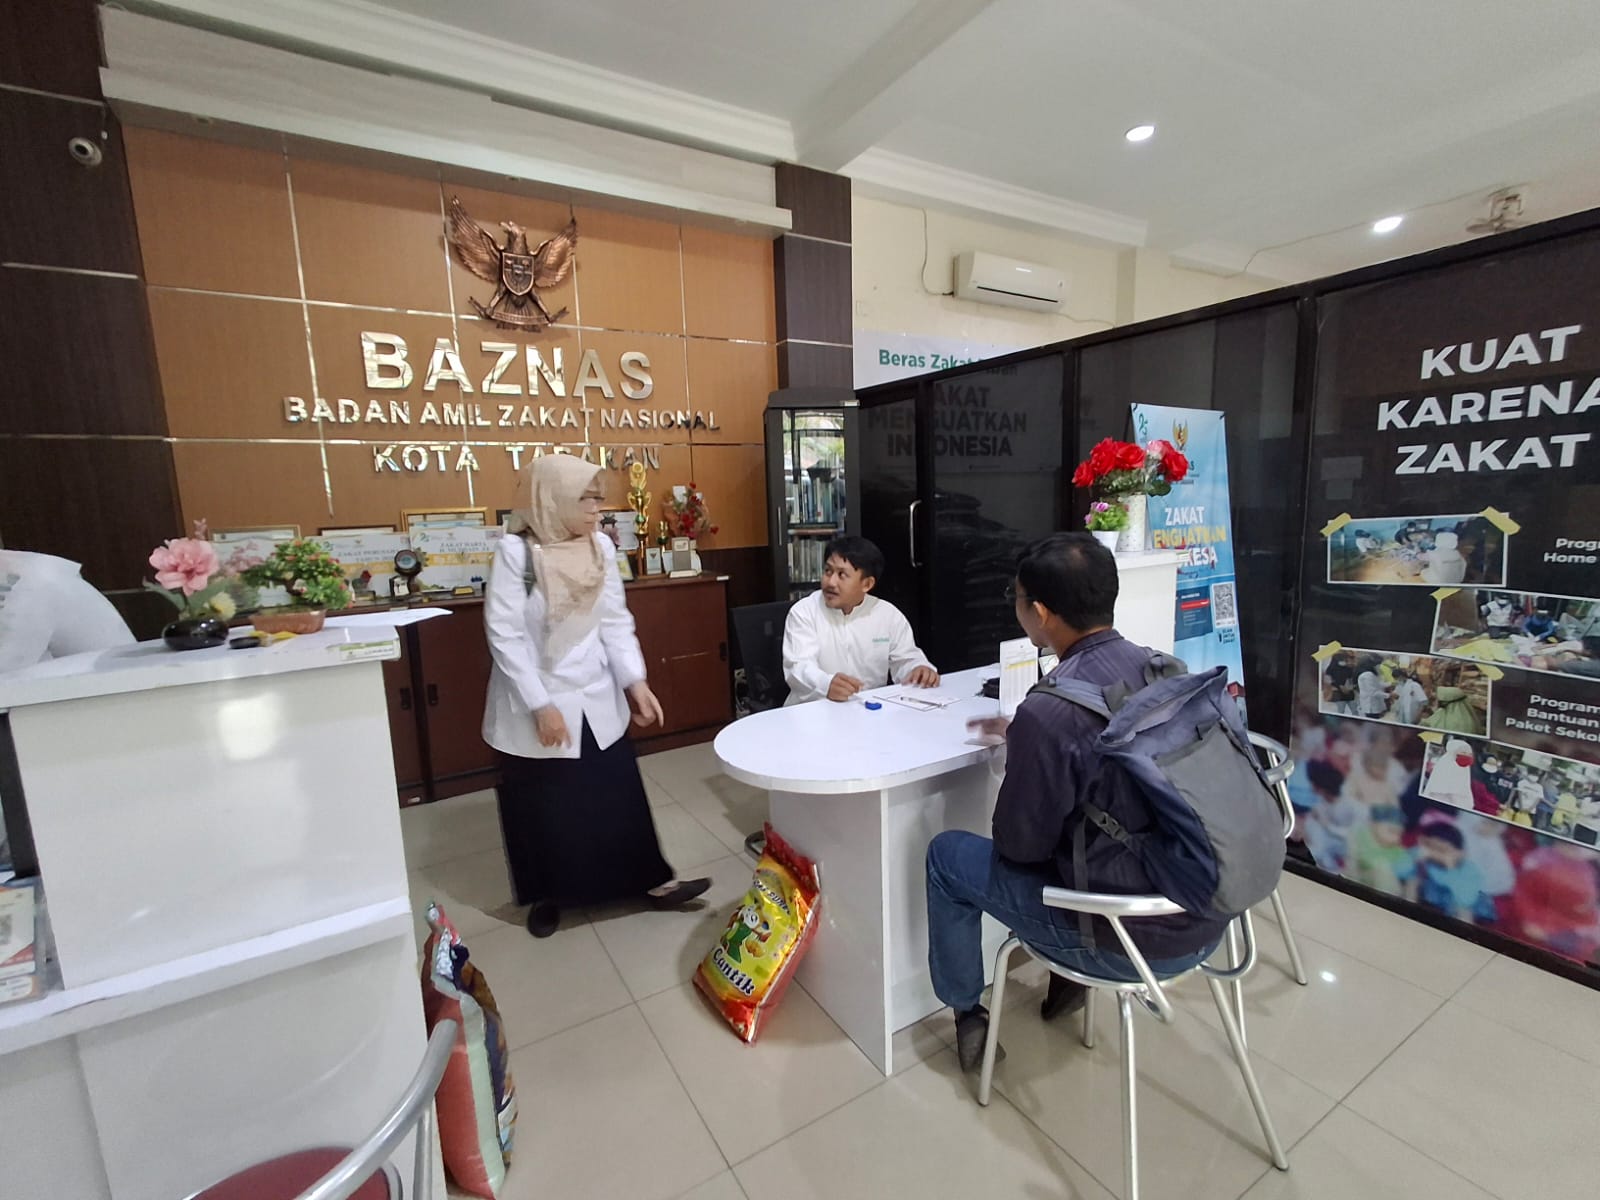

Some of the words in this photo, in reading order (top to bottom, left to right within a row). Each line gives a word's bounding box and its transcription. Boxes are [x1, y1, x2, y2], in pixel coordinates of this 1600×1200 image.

[879, 349, 926, 368] Beras
[1421, 325, 1581, 380] KUAT
[360, 331, 655, 400] BAZNAS
[933, 384, 991, 408] AKAT
[1377, 377, 1600, 431] KARENA
[284, 396, 411, 425] BADAN
[419, 401, 490, 427] AMIL
[497, 404, 595, 430] ZAKAT
[600, 407, 721, 432] NASIONAL
[888, 433, 1013, 457] INONESIA
[1395, 433, 1591, 475] ZAKAT
[373, 445, 480, 472] KOTA
[1165, 506, 1205, 527] ZAKAT
[1543, 552, 1597, 564] Home
[1530, 694, 1600, 714] Program
[1505, 717, 1551, 734] Paket
[1527, 708, 1599, 728] Bantuan
[713, 948, 755, 994] Cantik
